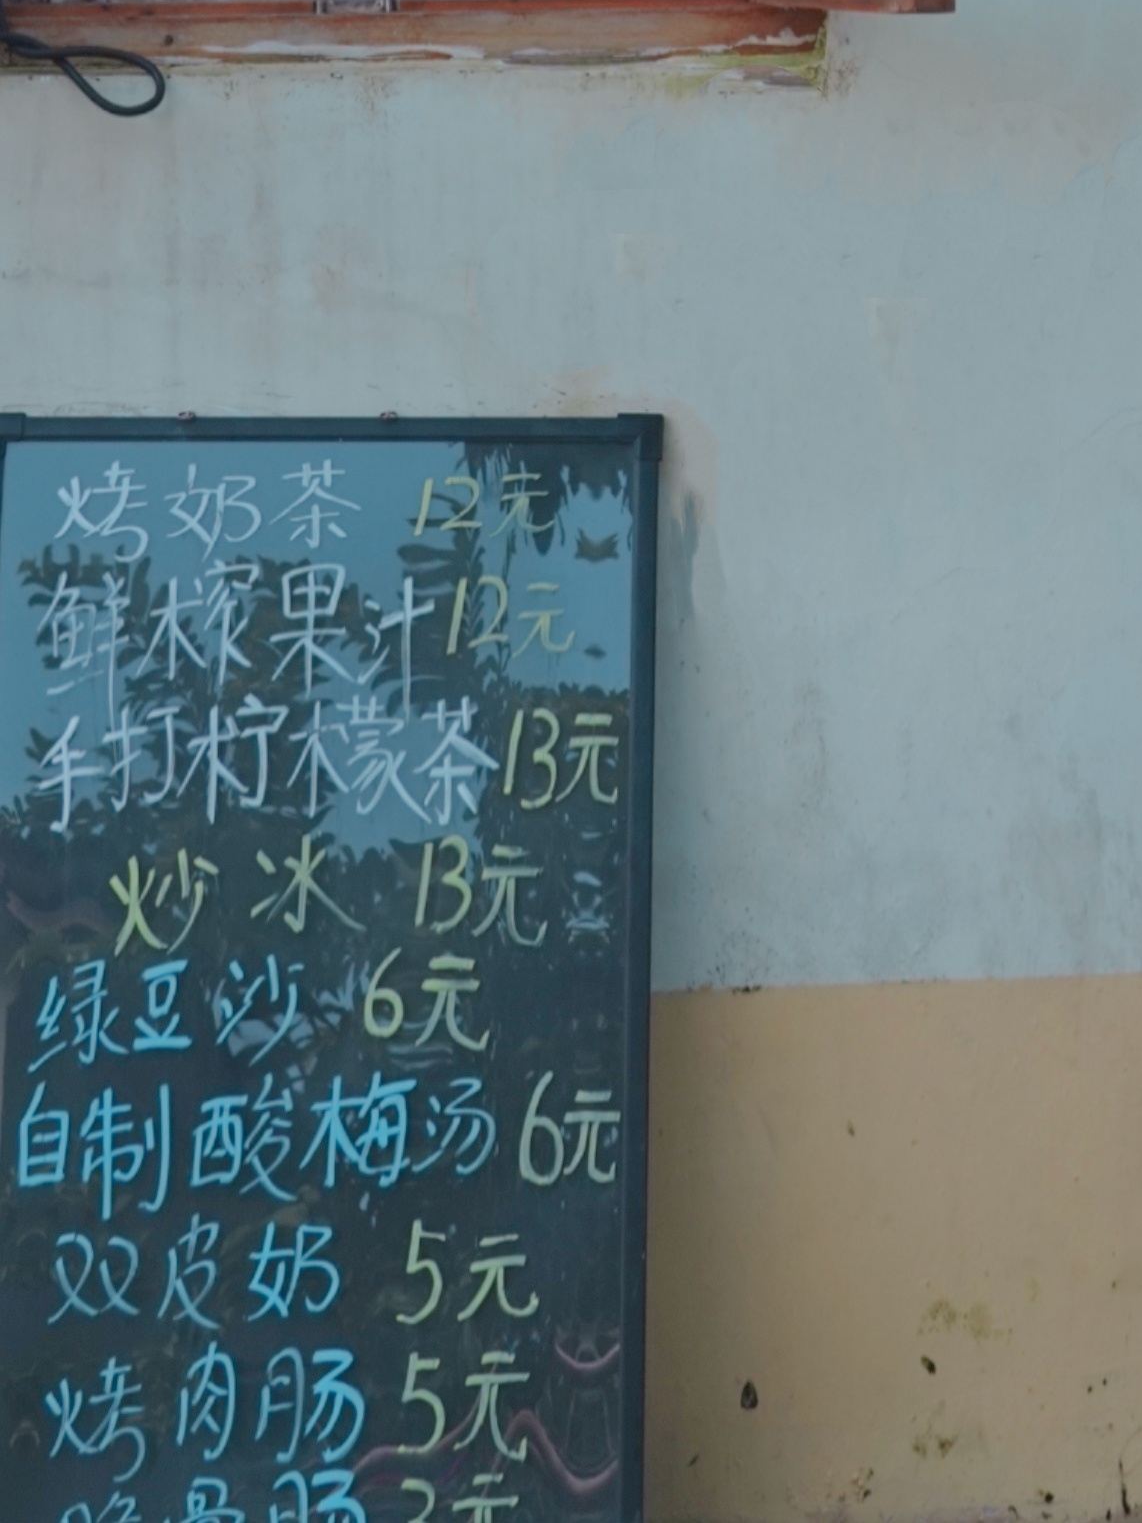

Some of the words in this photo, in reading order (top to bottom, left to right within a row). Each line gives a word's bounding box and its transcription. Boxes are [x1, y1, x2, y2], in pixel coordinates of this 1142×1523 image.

[55, 459, 362, 564] 烤奶茶
[414, 472, 556, 537] 12元
[446, 575, 576, 658] 12元
[39, 693, 500, 833] 手打柠檬茶
[502, 707, 620, 811] 13元
[109, 833, 368, 958] 炒冰
[414, 835, 549, 948] 13元
[27, 954, 305, 1073] 绿豆沙
[363, 947, 491, 1053] 6元
[17, 1071, 498, 1220] 自制酸梅汤
[518, 1071, 621, 1187] 6元
[47, 1214, 341, 1330] 双皮奶
[396, 1219, 540, 1325] 5元
[45, 1340, 367, 1483] 烤肉肠
[396, 1351, 531, 1462] 5元
